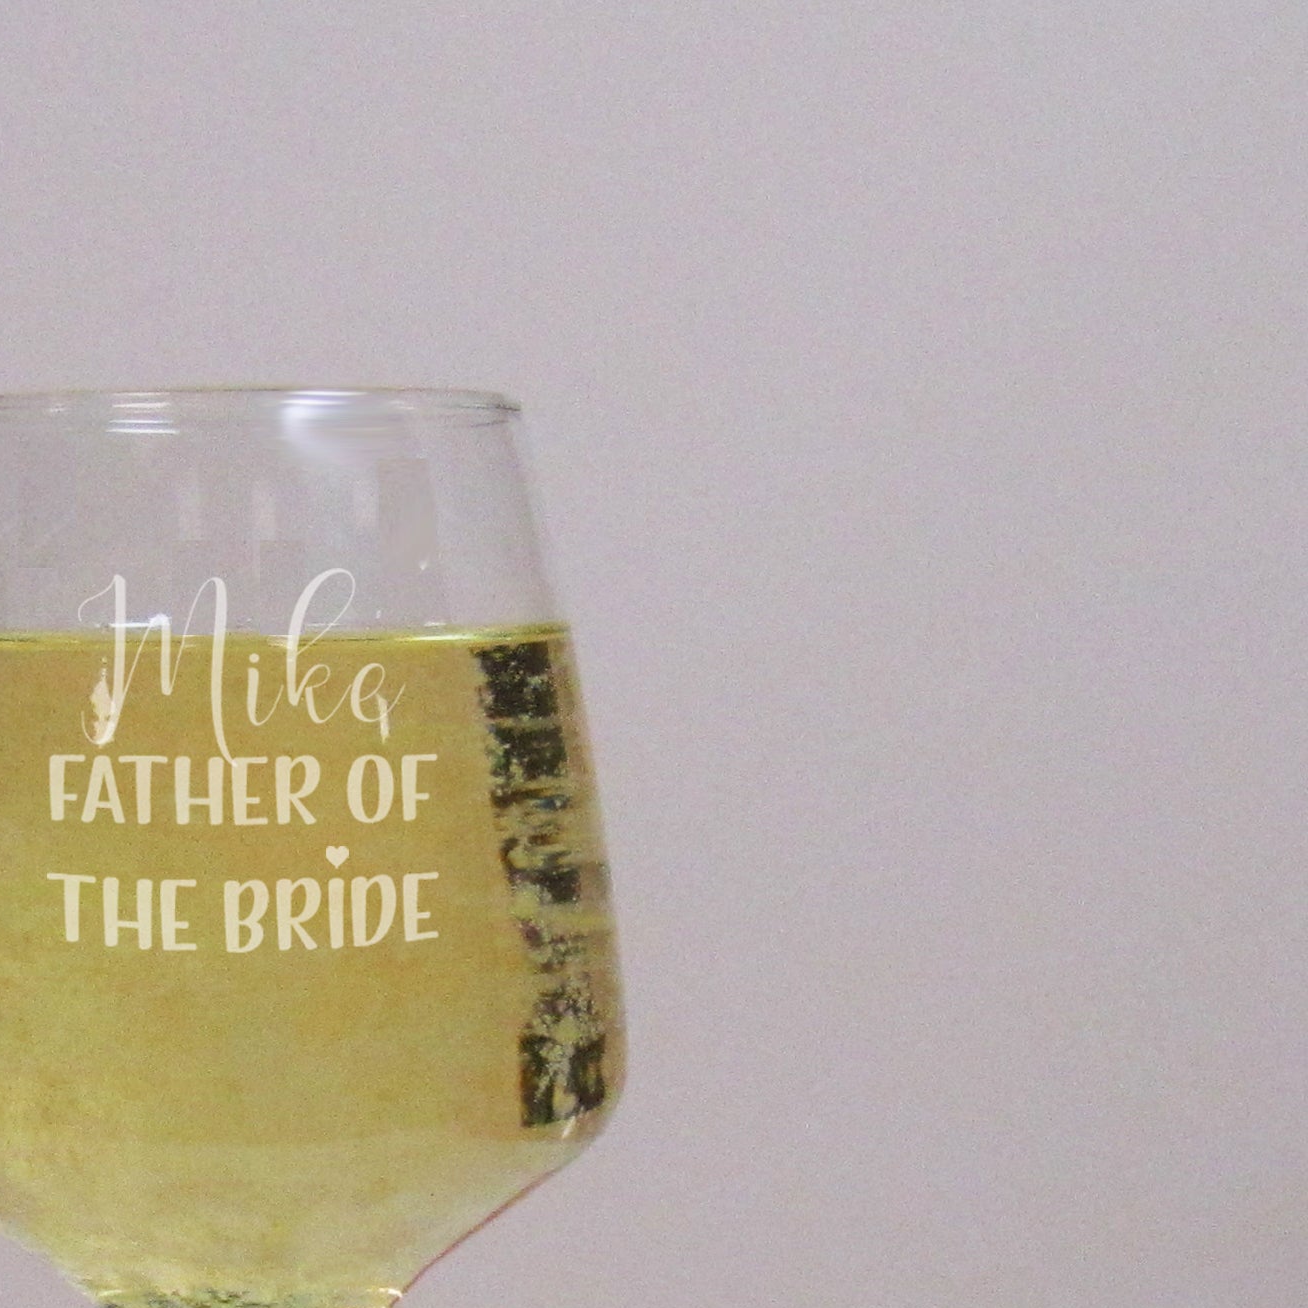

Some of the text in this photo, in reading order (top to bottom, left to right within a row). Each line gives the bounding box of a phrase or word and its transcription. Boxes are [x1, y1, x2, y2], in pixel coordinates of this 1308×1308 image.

[78, 567, 406, 767] Mike
[49, 753, 438, 826] FATHER OF
[46, 872, 198, 951] THE
